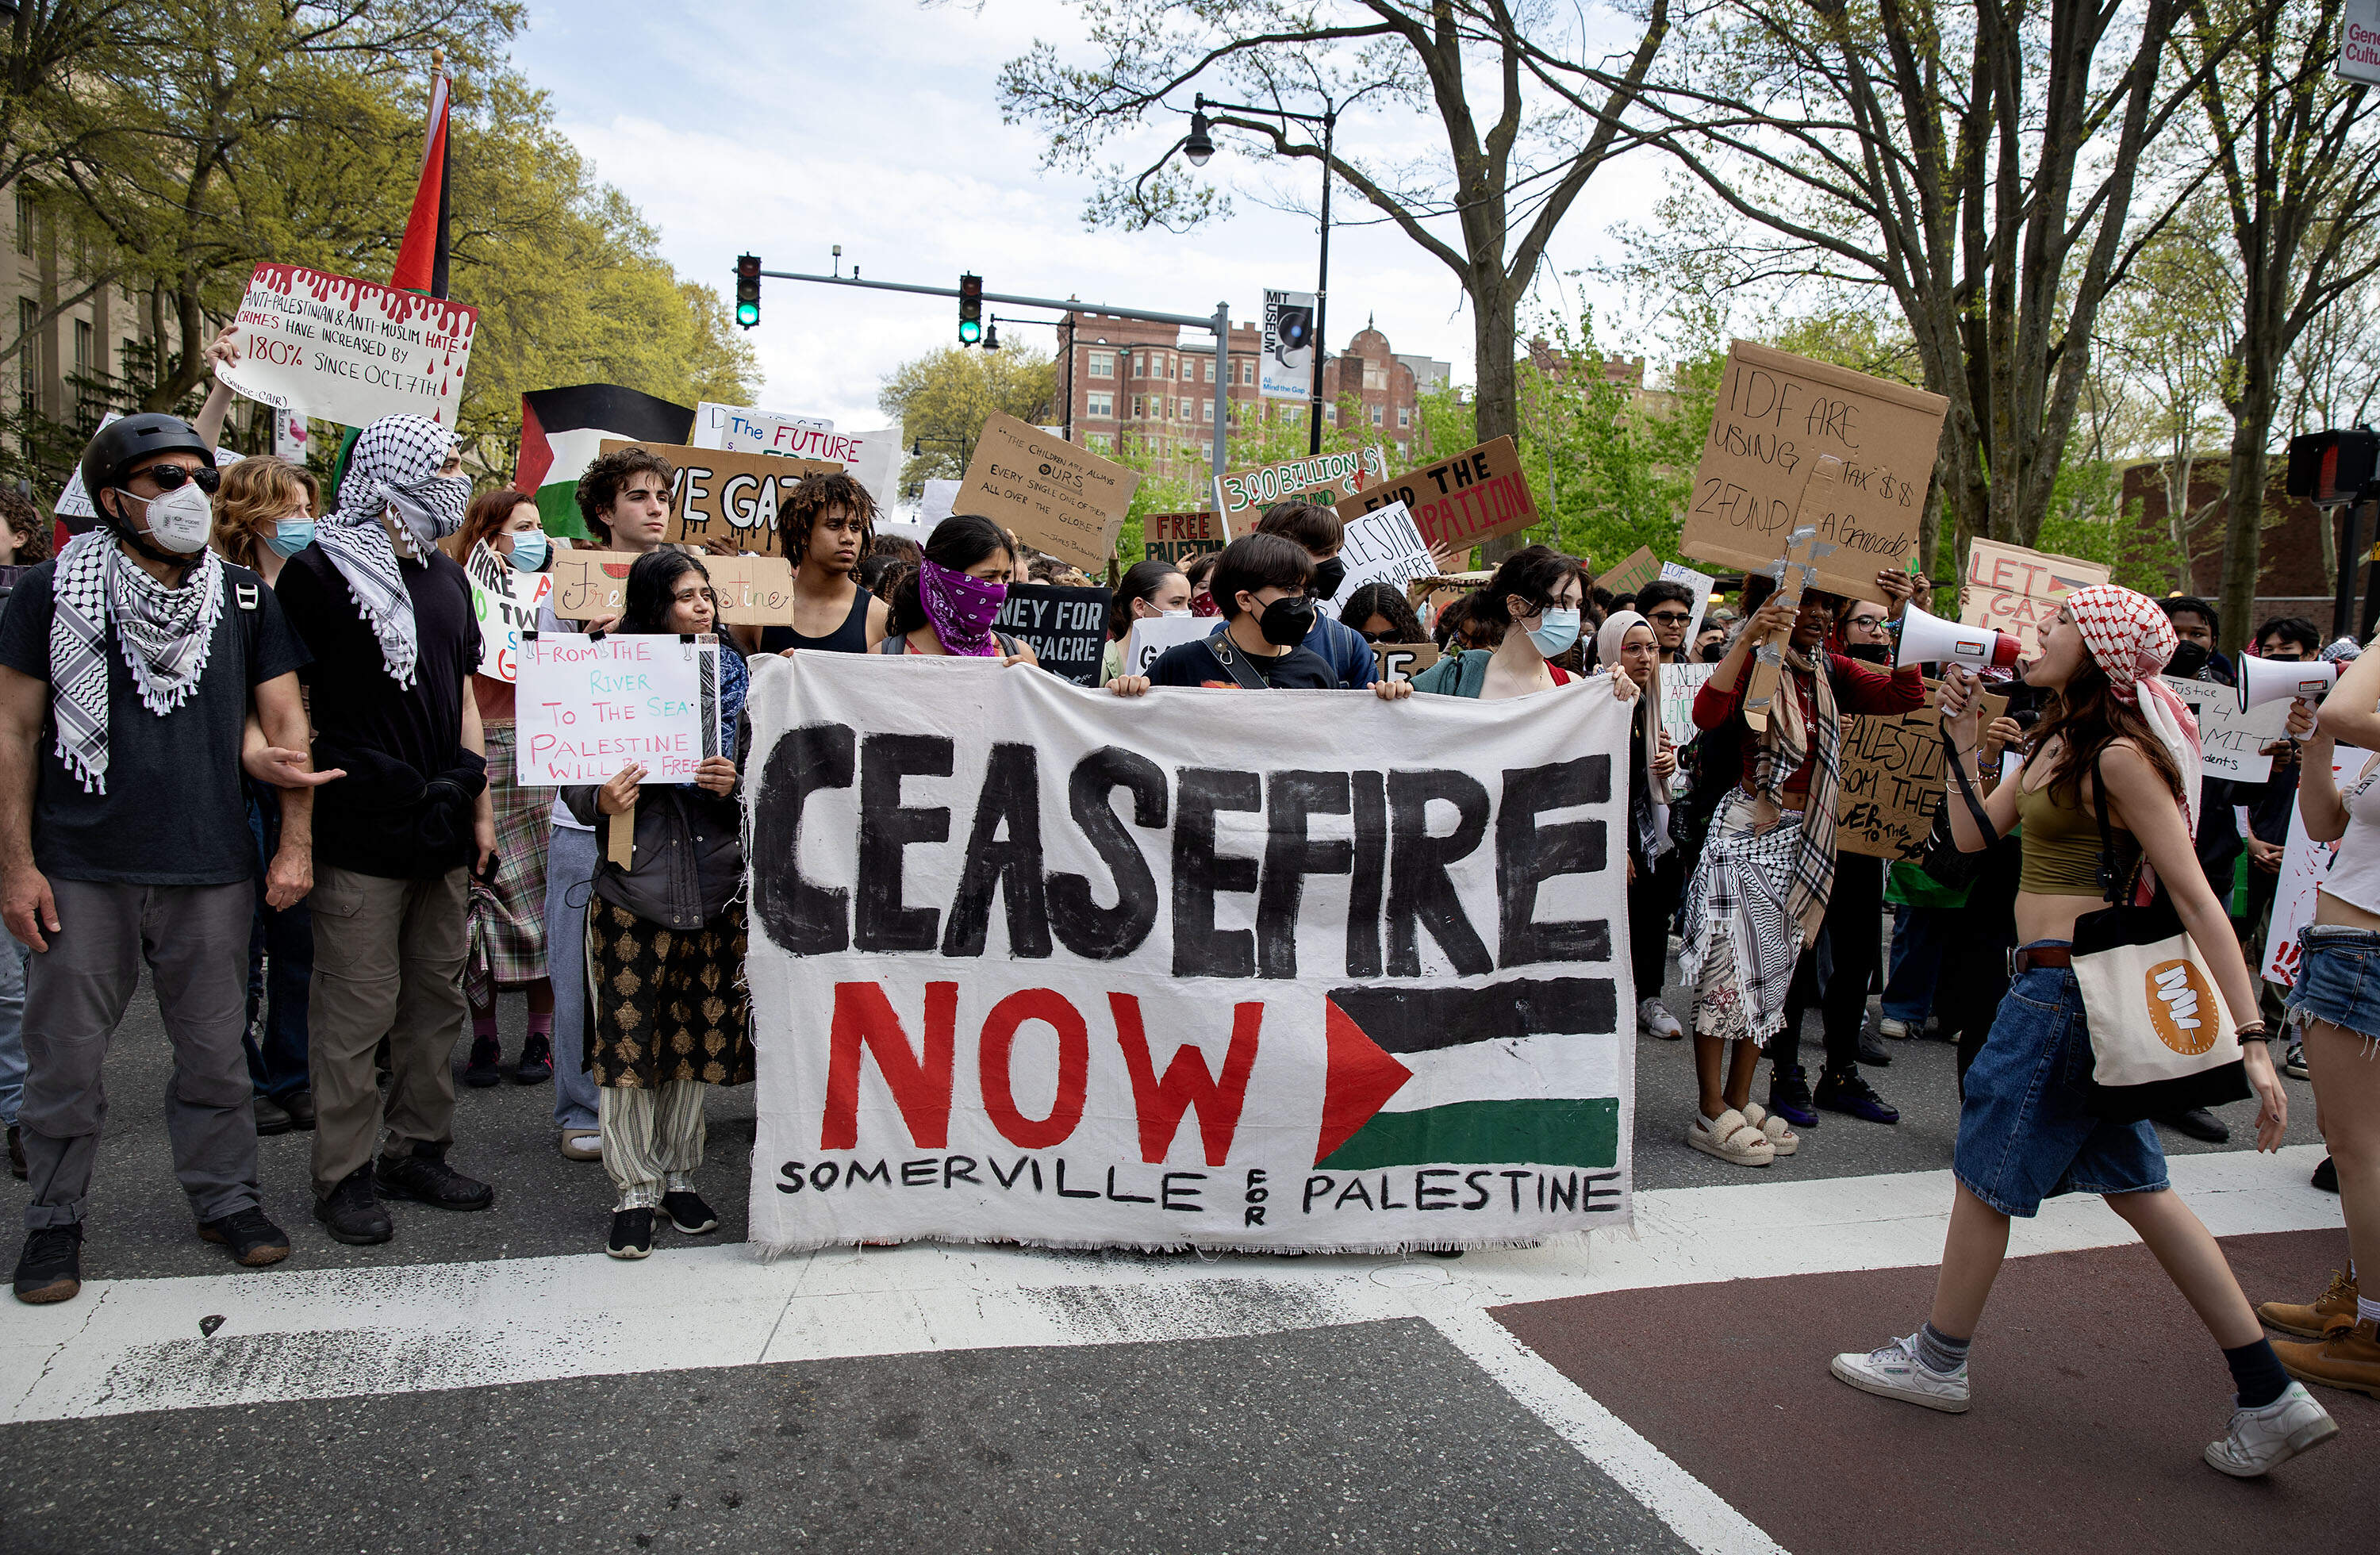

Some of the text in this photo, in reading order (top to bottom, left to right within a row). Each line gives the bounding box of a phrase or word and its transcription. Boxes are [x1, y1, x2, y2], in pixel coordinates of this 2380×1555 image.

[1267, 291, 1290, 304] MIT
[238, 310, 409, 364] CRIMES HAVE INCREASED BY
[243, 290, 459, 353] ANTI-PALESTINIAN & ANTI-MUSLIM HATE
[248, 333, 303, 367] 180%
[314, 352, 359, 379] SINCE
[364, 364, 402, 390] OCT.
[1292, 386, 1306, 395] Gap
[1730, 367, 1860, 448] IDF ARE
[731, 417, 764, 440] The
[774, 425, 863, 463] FUTURE
[1714, 420, 1799, 475] USING
[1028, 444, 1067, 466] CHILDREN
[1069, 462, 1084, 474] ARE
[1086, 469, 1115, 486] ALWAYS
[1426, 451, 1491, 496] THE
[1842, 461, 1877, 491] TAX
[981, 482, 1000, 496] ALL
[1004, 490, 1029, 505] OVER
[1035, 502, 1051, 515] THE
[990, 464, 1023, 483] EVERY
[1027, 480, 1058, 497] SINGLE
[1059, 493, 1075, 506] ONE
[1077, 501, 1088, 512] OF
[1157, 513, 1211, 539] FREE
[1821, 513, 1836, 541] A
[470, 542, 517, 600] THERE
[556, 561, 789, 611] Fre stine
[1969, 551, 2048, 597] LET
[1055, 601, 1104, 631] FOR
[535, 639, 598, 665] FROM
[607, 640, 653, 662] THE
[589, 670, 653, 695] RIVER
[1671, 685, 1702, 699] AFTE
[2167, 679, 2217, 698] Justice
[592, 701, 635, 723] THE
[2213, 704, 2232, 722] 4
[530, 733, 689, 766] PALESTINE
[547, 761, 613, 780] WILL
[662, 755, 701, 777] FREE
[1891, 775, 1944, 818] THE
[753, 720, 1612, 979] CEASEFIRE
[1862, 828, 1881, 843] TO
[819, 981, 1265, 1168] NOW
[776, 1154, 1622, 1228] SOMERVILLE FOR PALESTINE
